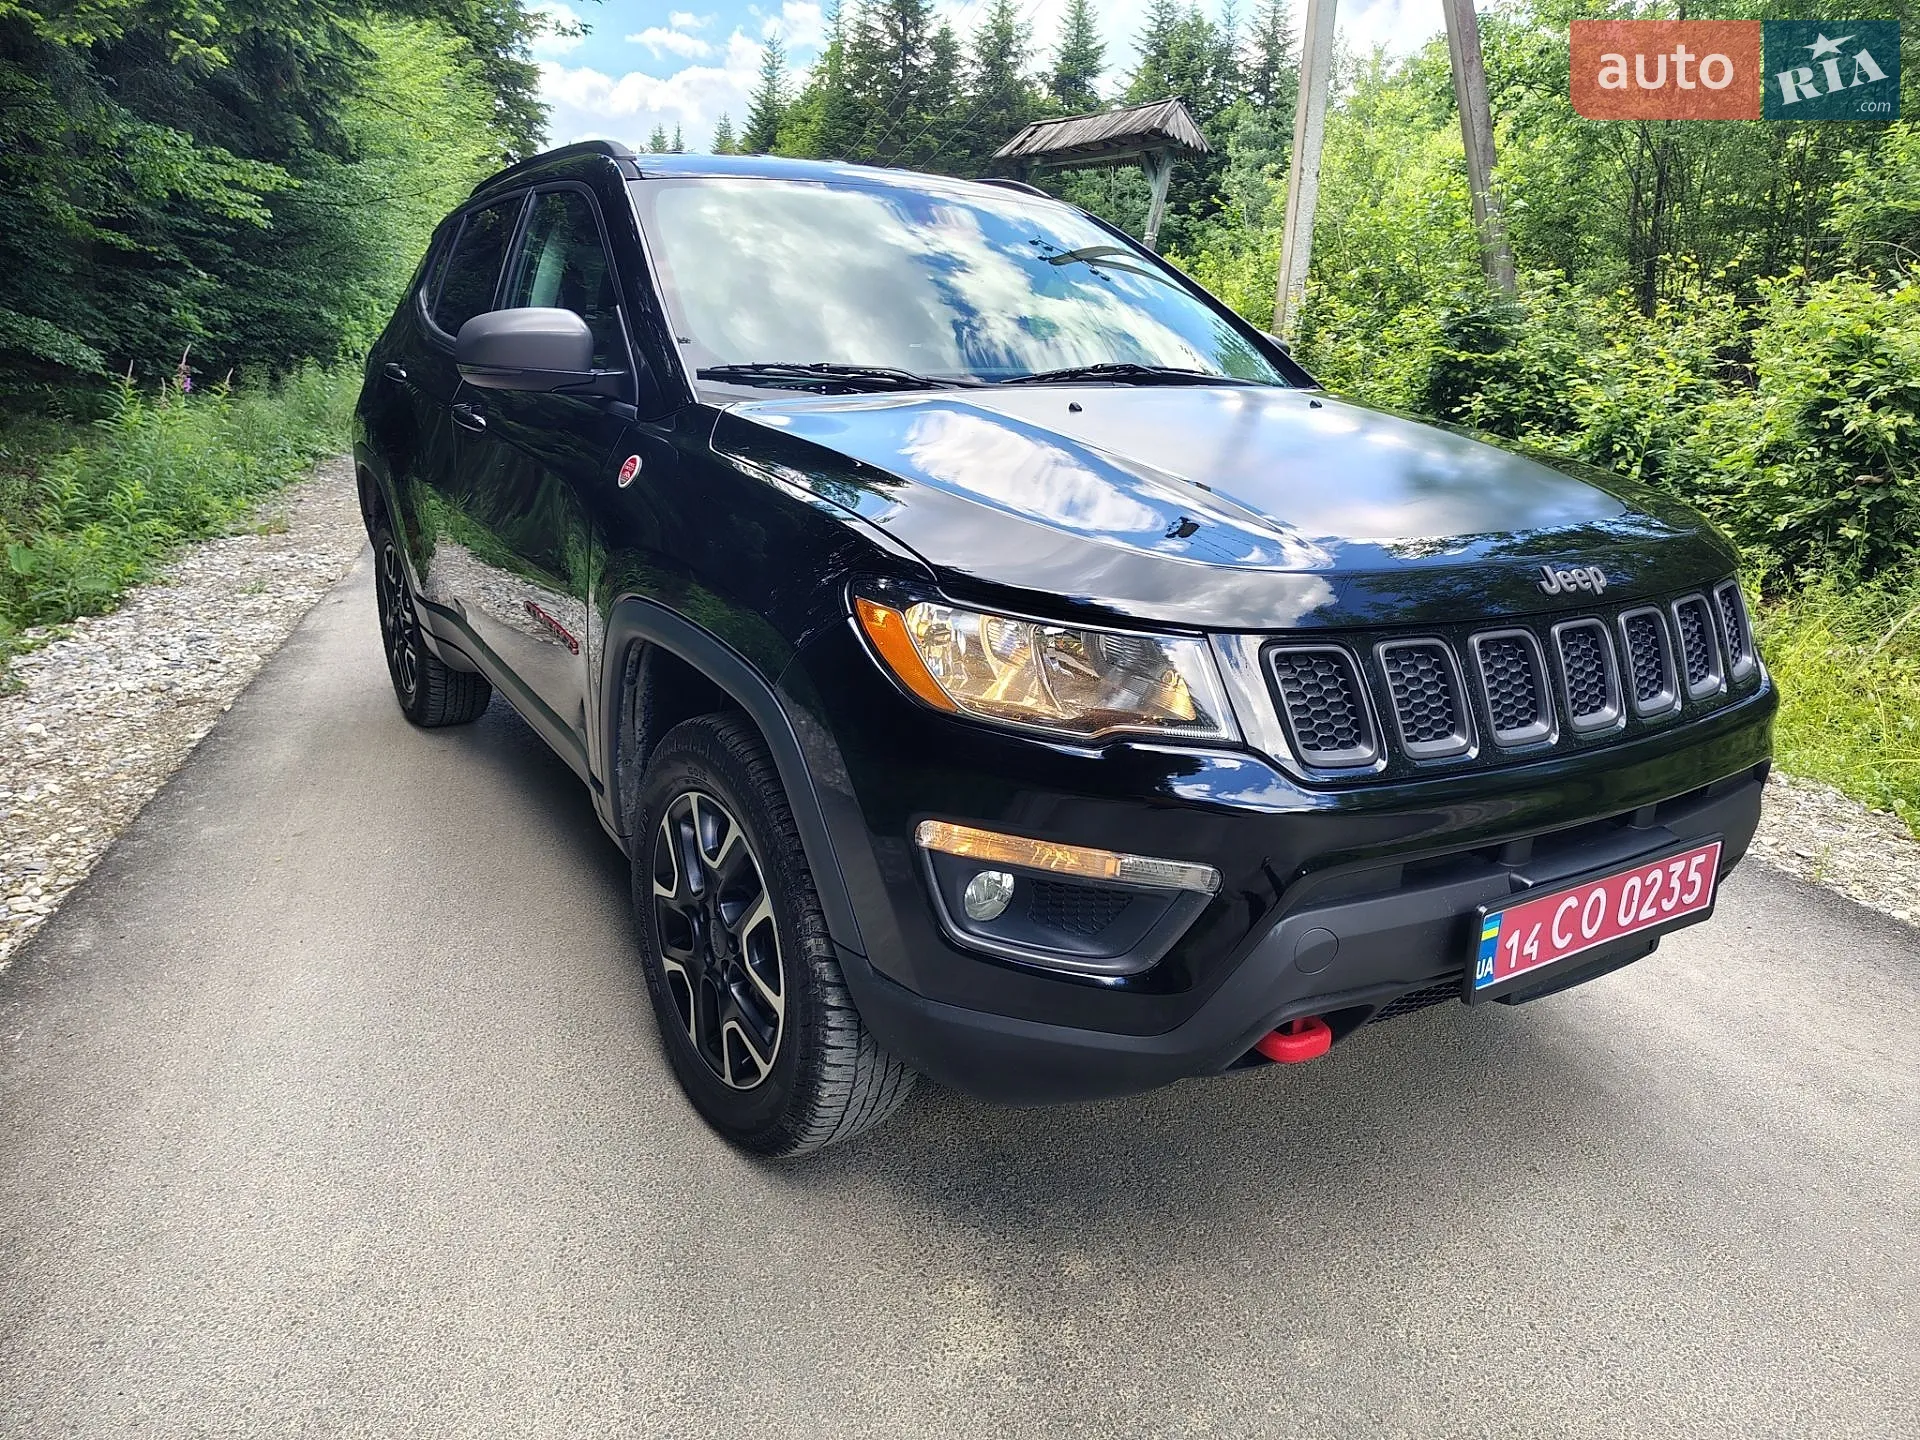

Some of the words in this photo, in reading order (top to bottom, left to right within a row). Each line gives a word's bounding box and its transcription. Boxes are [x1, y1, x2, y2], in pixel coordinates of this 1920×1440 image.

[1539, 565, 1607, 595] Jeep
[1505, 922, 1542, 969] 14
[1551, 887, 1607, 950] CO
[1617, 853, 1707, 927] 0235
[1476, 957, 1494, 979] UA
